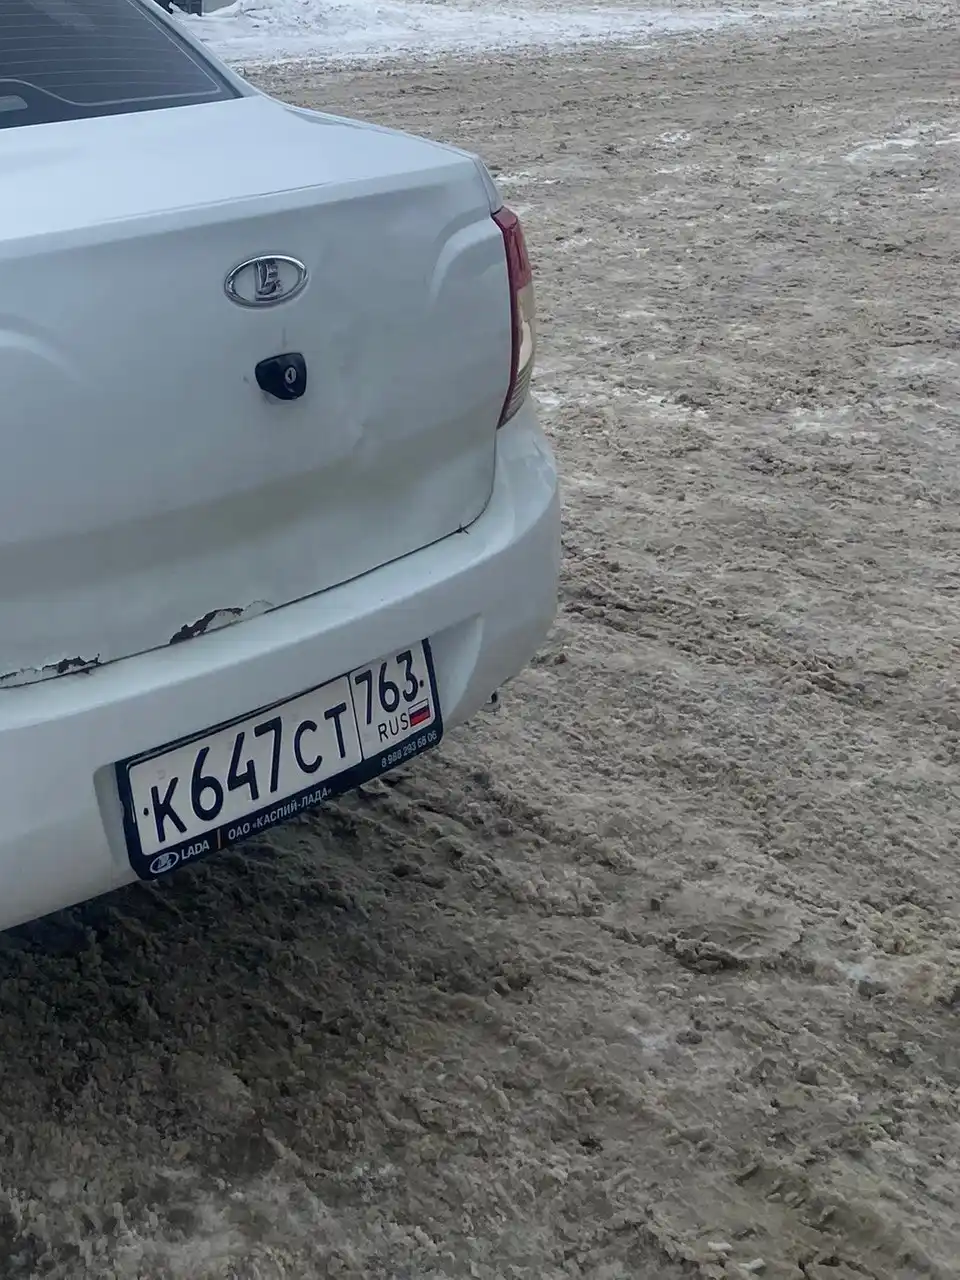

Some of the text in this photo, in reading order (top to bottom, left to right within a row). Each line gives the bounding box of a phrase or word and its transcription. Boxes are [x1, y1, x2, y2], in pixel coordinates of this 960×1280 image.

[378, 712, 410, 743] RUS
[150, 649, 419, 843] К647СТ 763
[228, 822, 251, 840] ОАО
[181, 839, 210, 860] LADA
